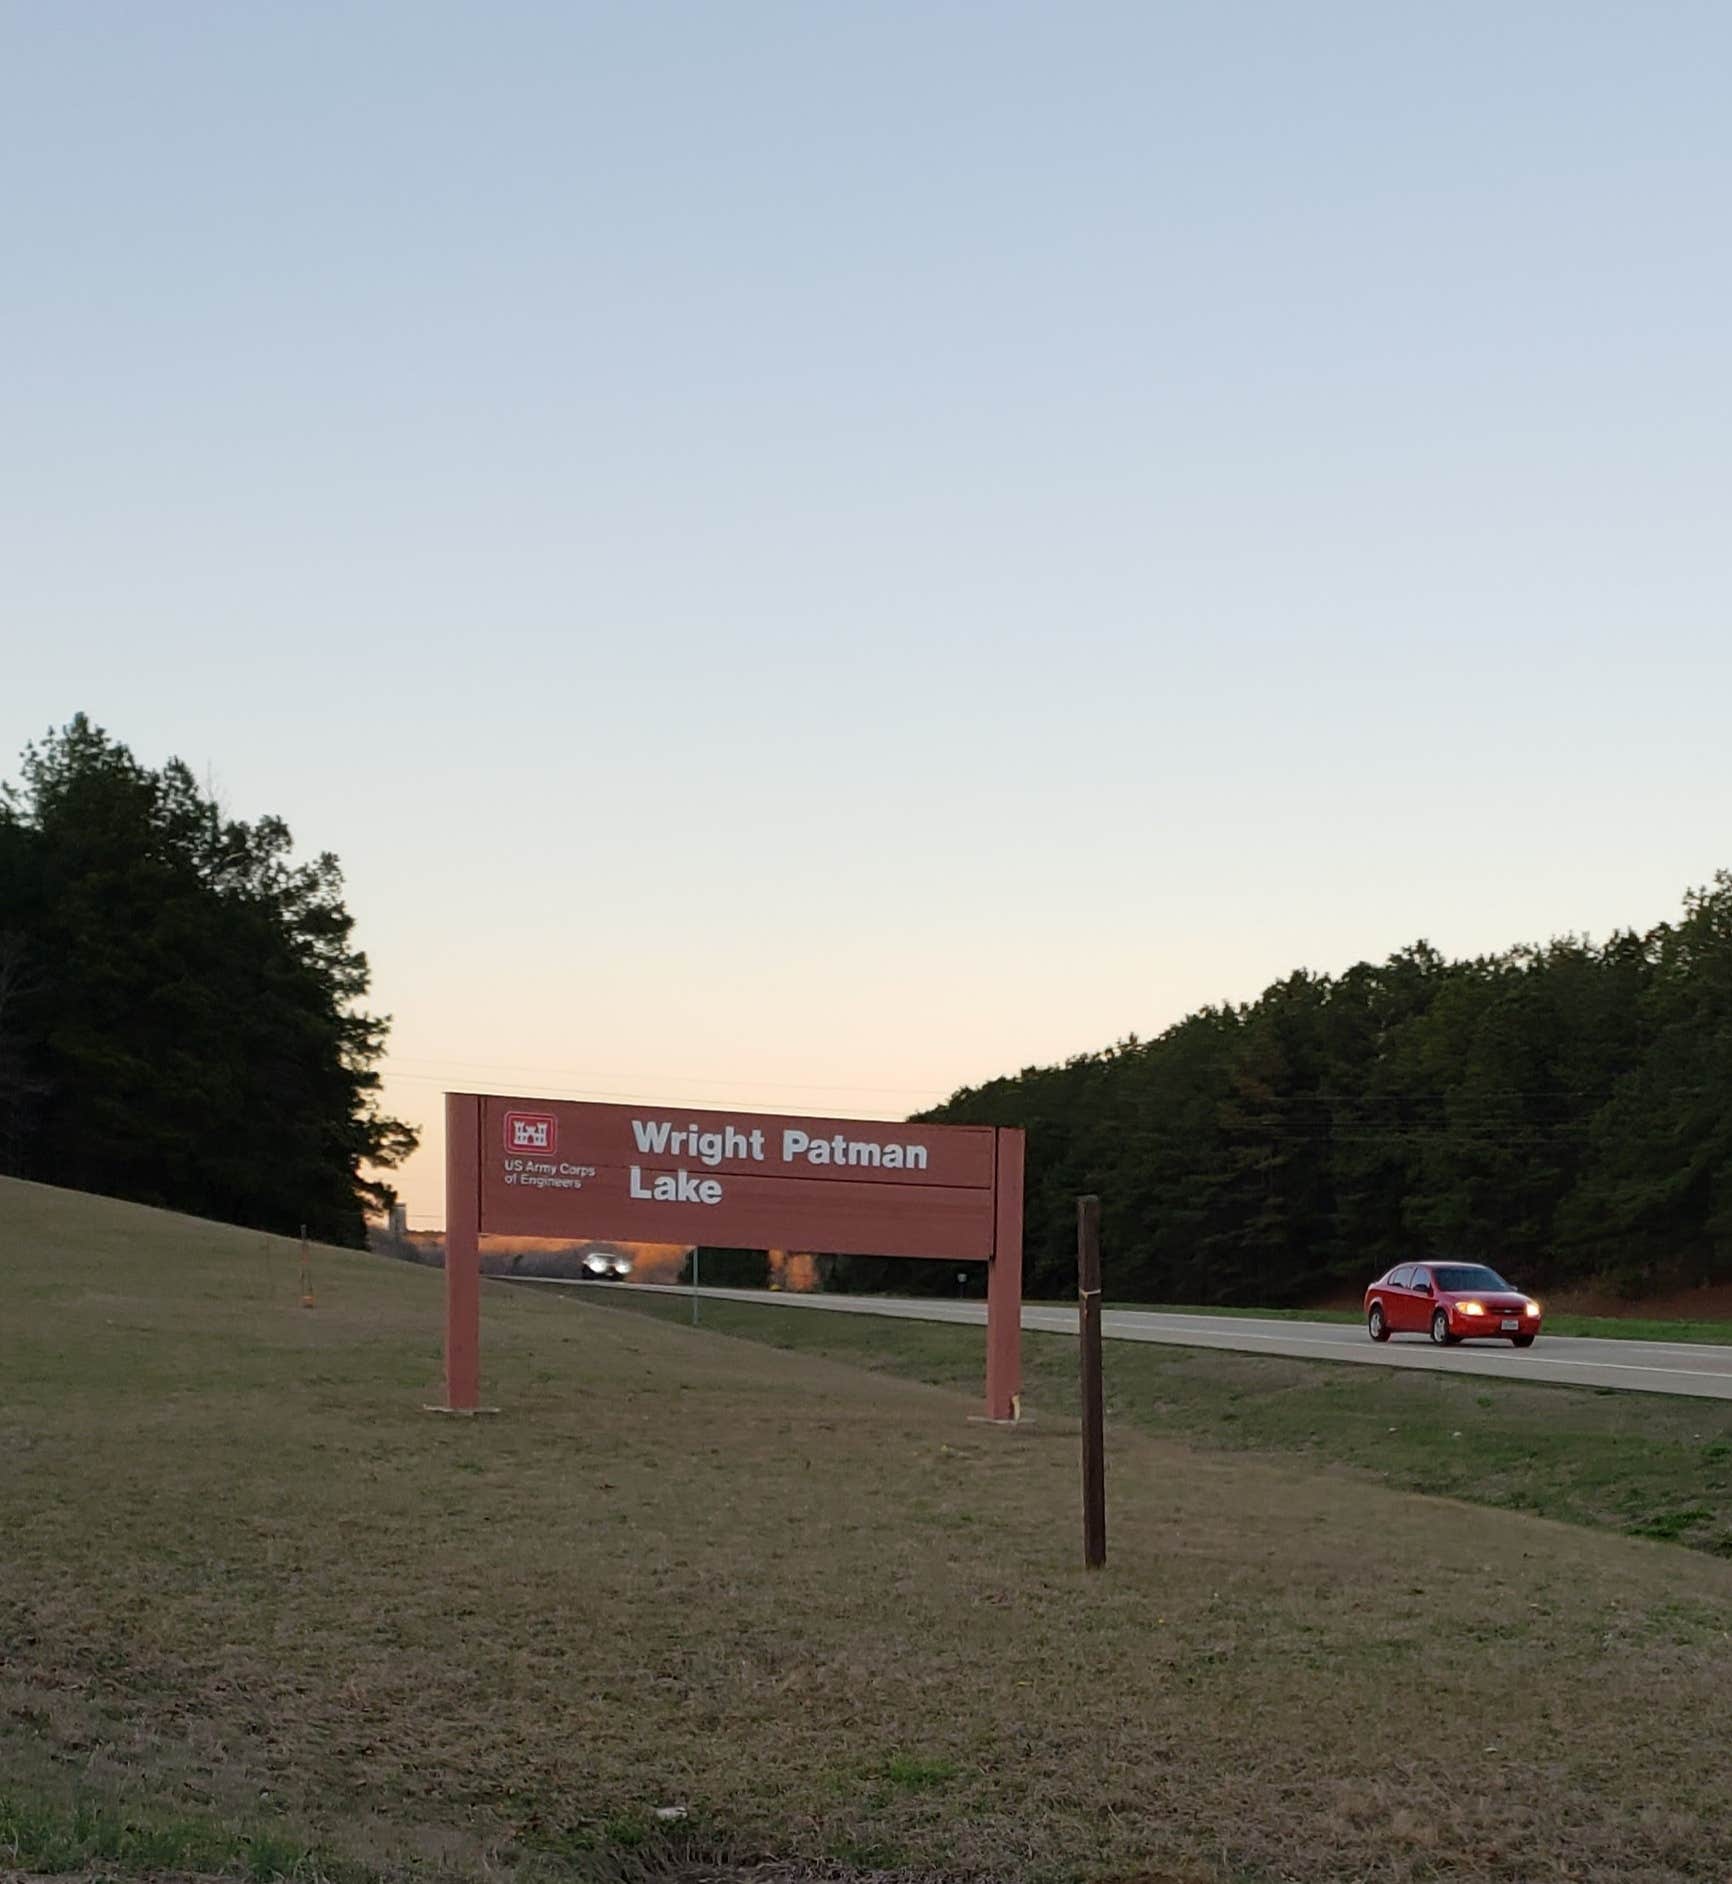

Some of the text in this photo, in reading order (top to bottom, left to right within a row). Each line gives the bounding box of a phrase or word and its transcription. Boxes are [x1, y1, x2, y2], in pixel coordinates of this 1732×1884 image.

[631, 1120, 928, 1169] Wright Patman
[504, 1159, 596, 1177] US Army Corps
[504, 1173, 582, 1189] of Engineers
[630, 1165, 722, 1204] Lake
